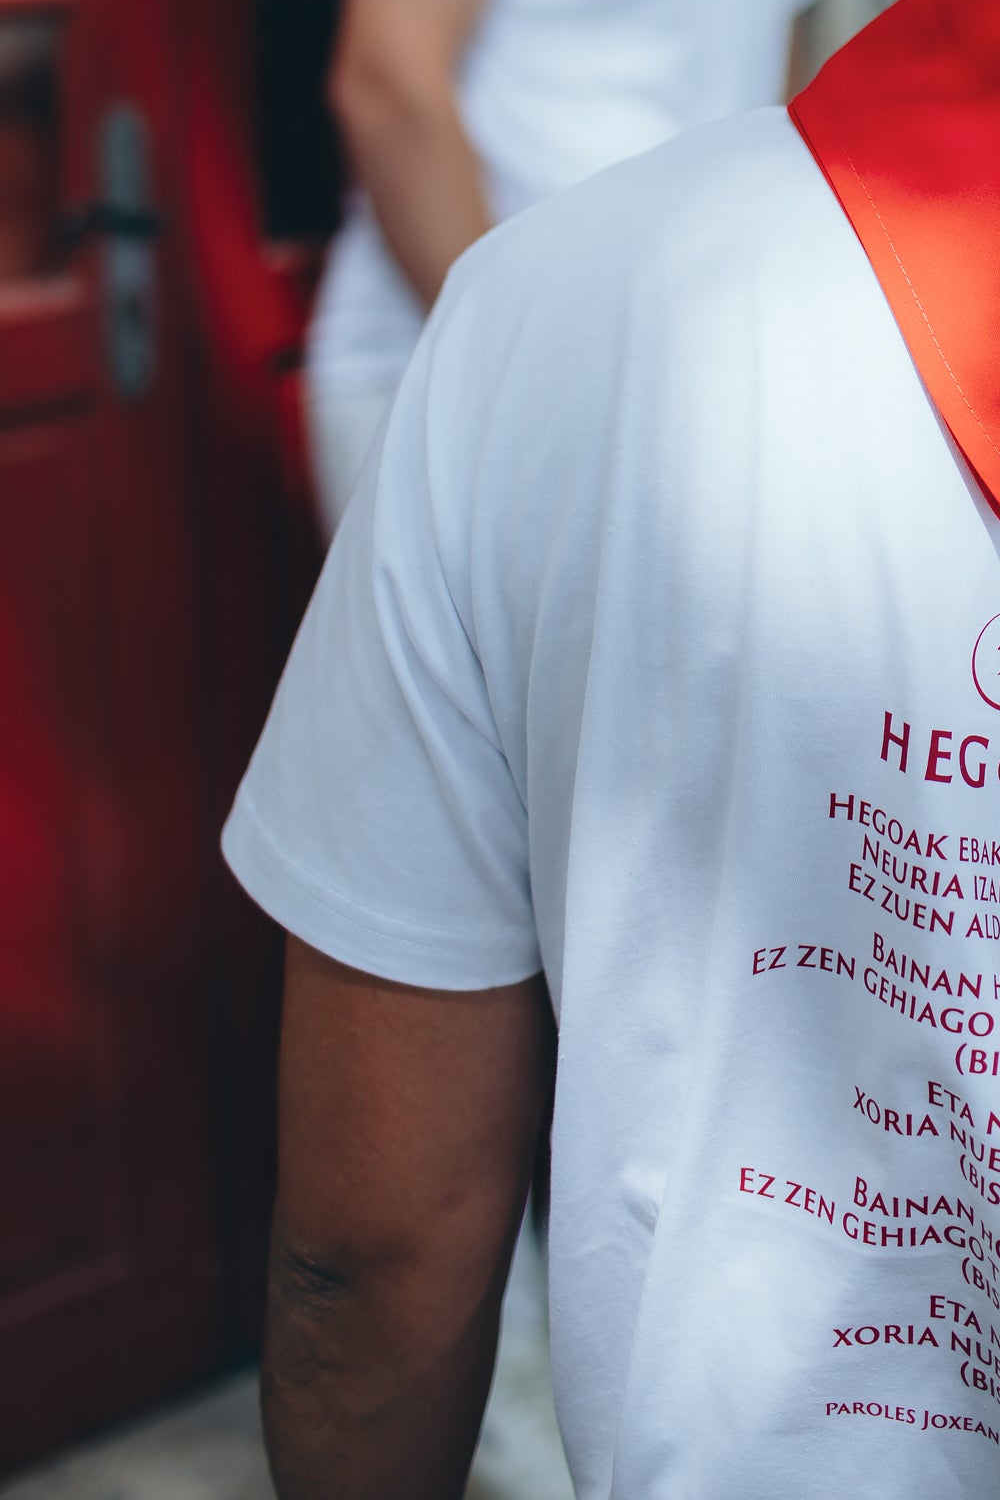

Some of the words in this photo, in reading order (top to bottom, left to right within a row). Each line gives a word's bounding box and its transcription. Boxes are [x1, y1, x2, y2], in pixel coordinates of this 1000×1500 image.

[829, 792, 948, 861] HEGOAK
[862, 833, 964, 900] NEURIA
[848, 862, 877, 901] EZ
[881, 884, 955, 936] ZUEN
[752, 946, 787, 975] EZ
[797, 944, 856, 980] ZEN
[863, 967, 996, 1038] GEHIAGO
[872, 931, 983, 1000] BAINAN
[853, 1086, 940, 1137] XORIA
[927, 1080, 975, 1128] ETA
[739, 1167, 776, 1199] EZ
[783, 1180, 836, 1225] ZEN
[842, 1212, 985, 1262] GEHIAGO
[853, 1176, 975, 1227] BAINAN
[832, 1324, 939, 1349] XORIA
[929, 1294, 983, 1335] ETA
[825, 1401, 916, 1425] PAROLES
[921, 1408, 999, 1445] JOXEAN
